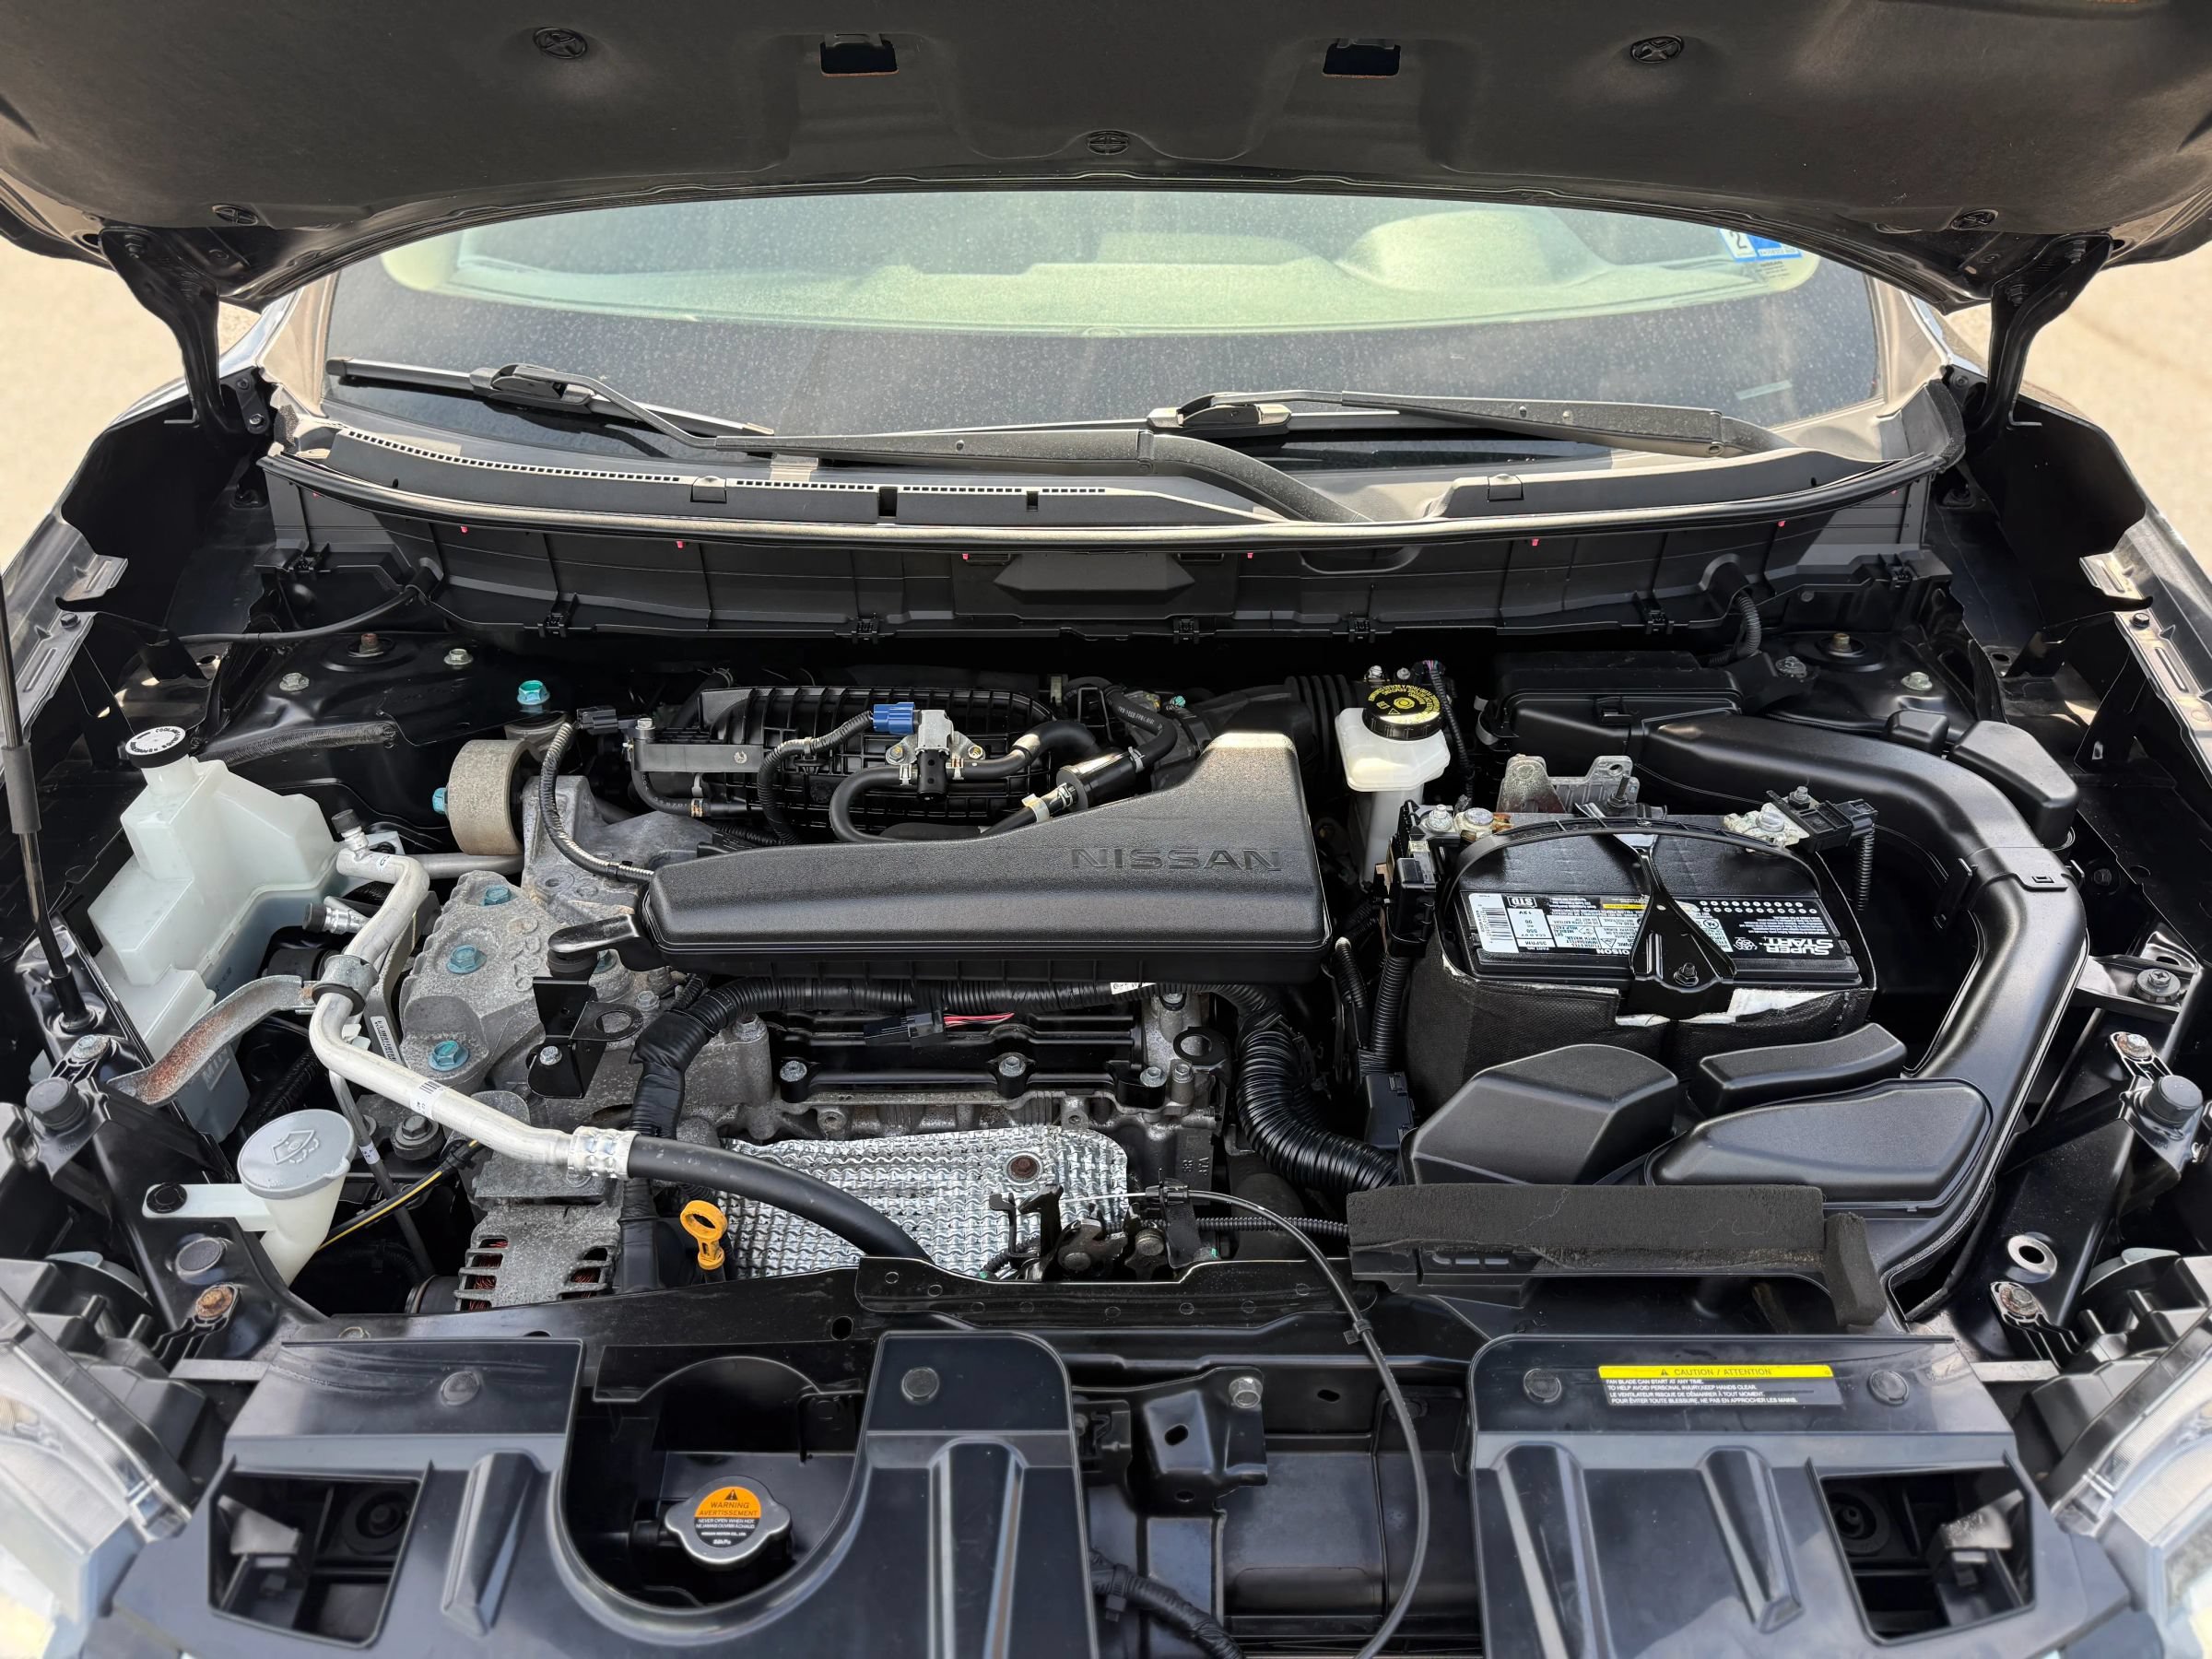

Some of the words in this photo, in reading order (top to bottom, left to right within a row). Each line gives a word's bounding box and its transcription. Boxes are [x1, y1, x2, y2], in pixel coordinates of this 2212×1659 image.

[1071, 848, 1282, 871] NISSAN
[1764, 938, 1834, 949] START
[1766, 945, 1830, 955] SUPER
